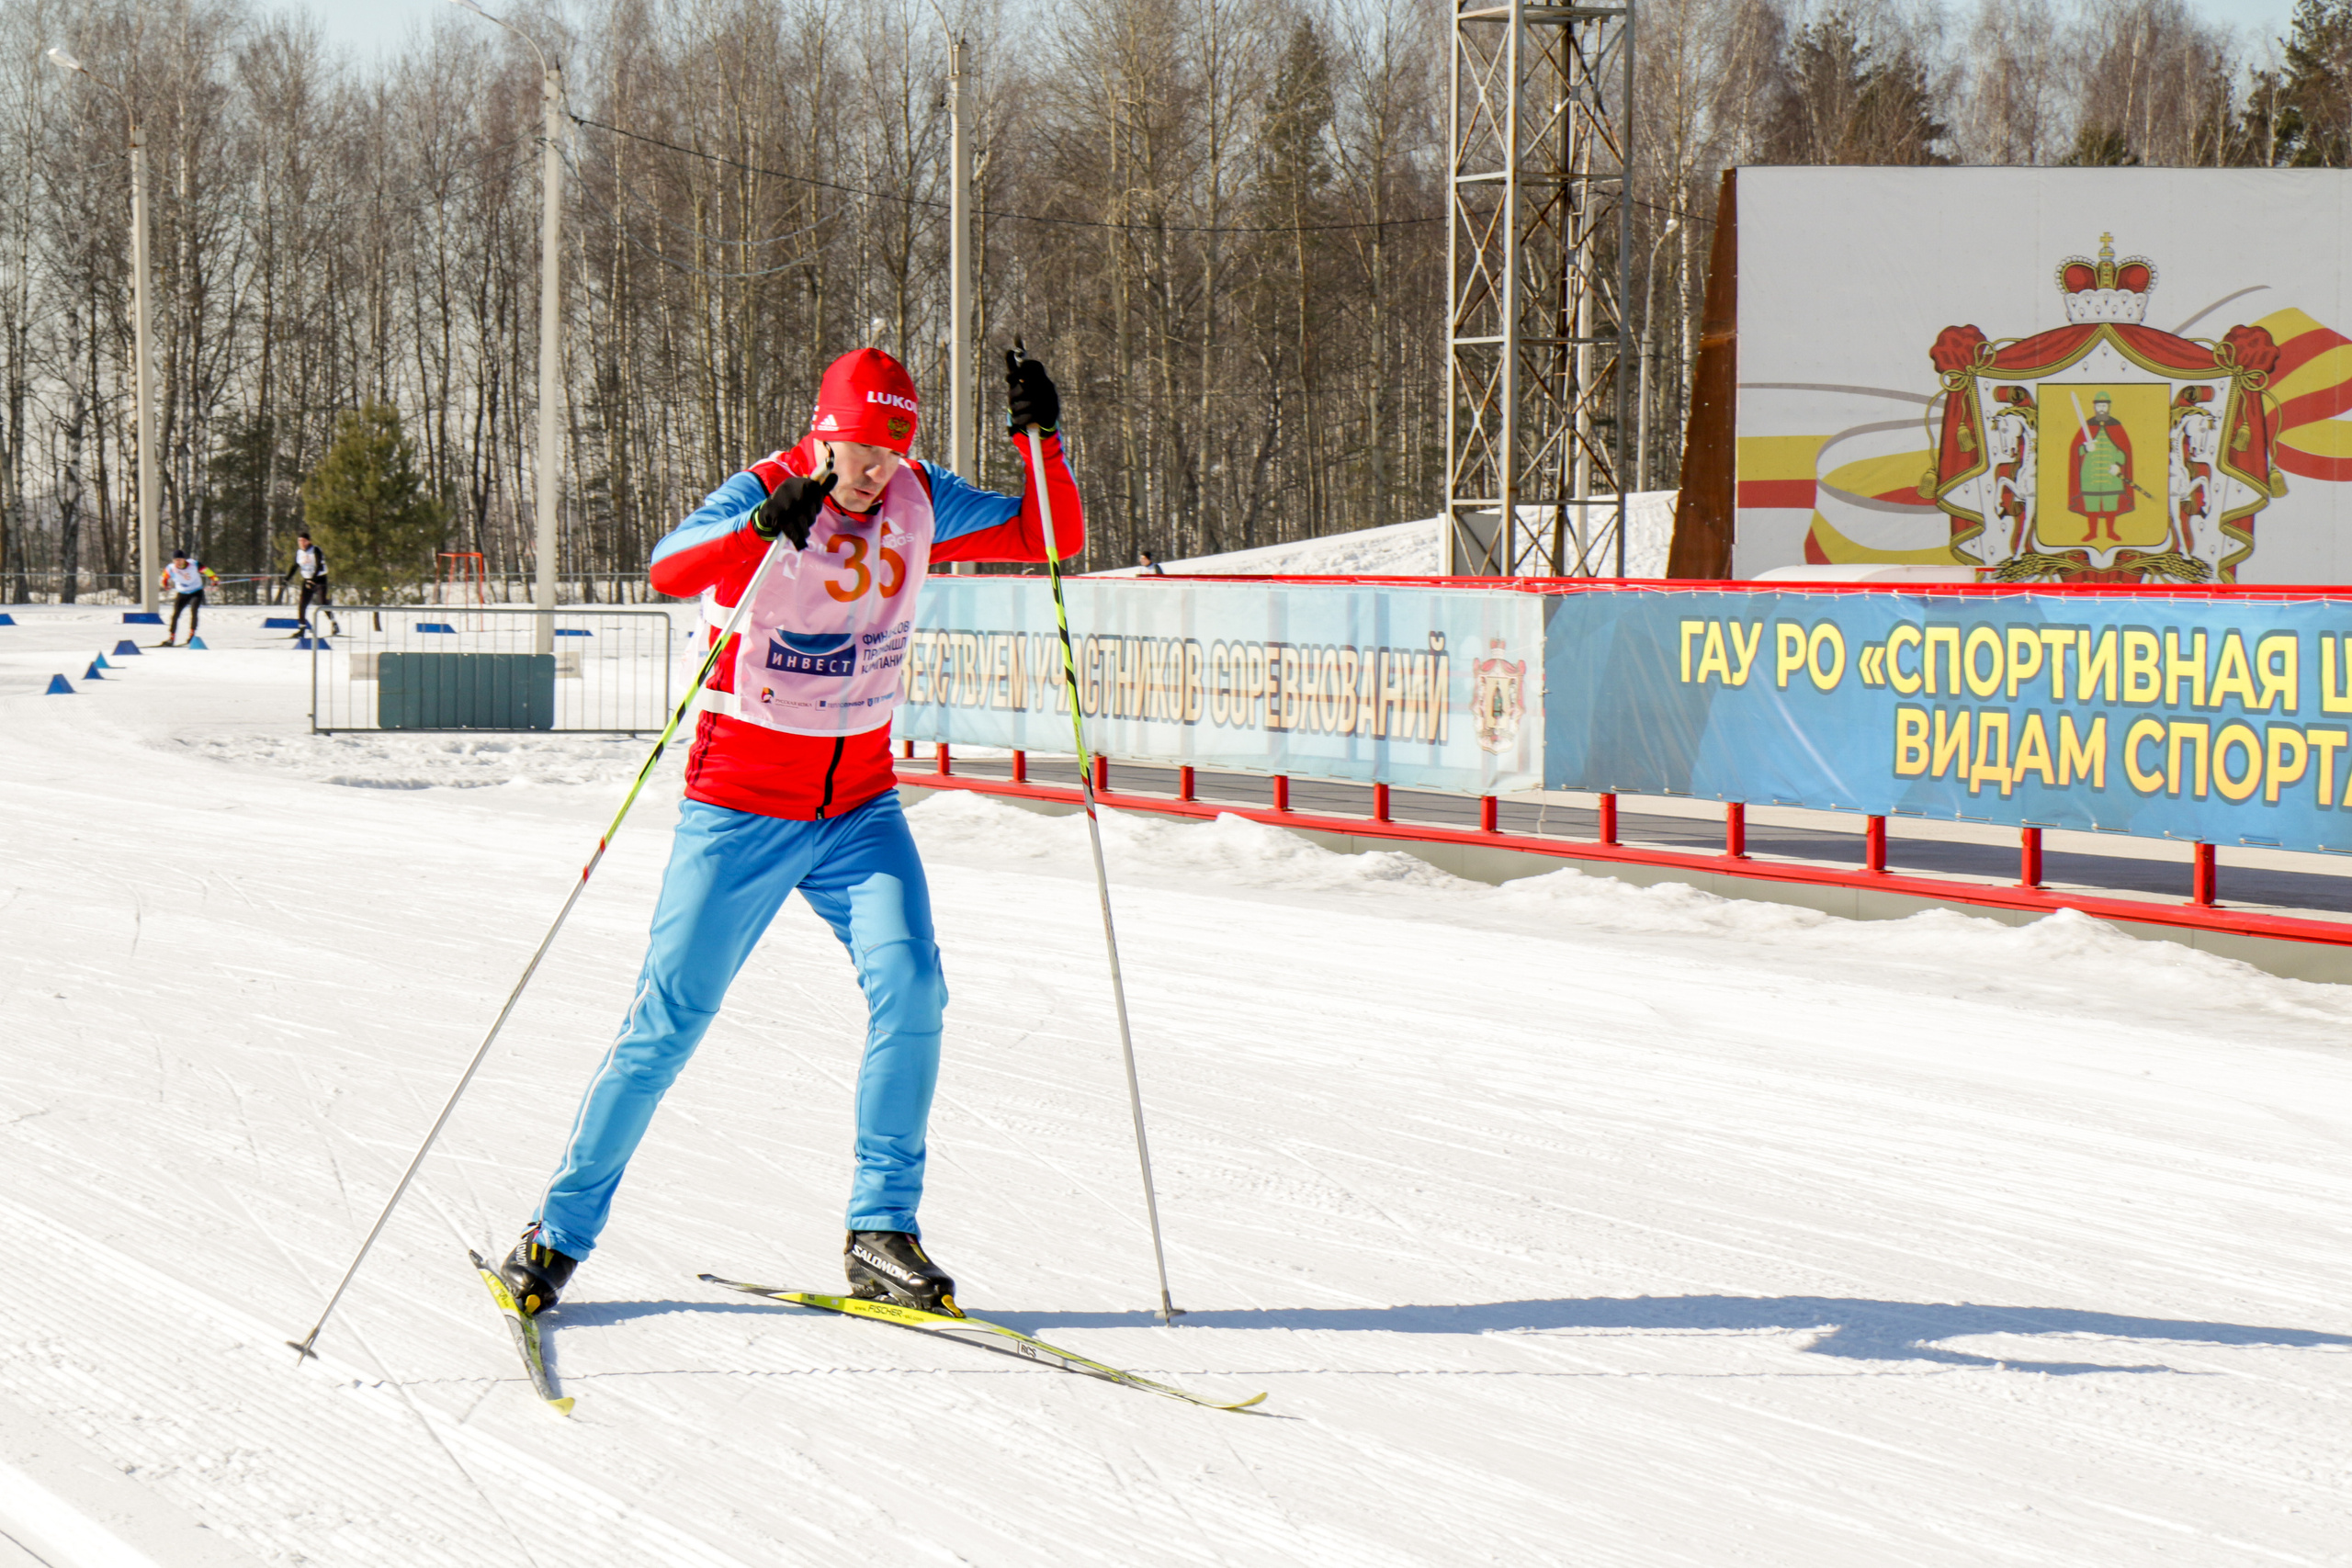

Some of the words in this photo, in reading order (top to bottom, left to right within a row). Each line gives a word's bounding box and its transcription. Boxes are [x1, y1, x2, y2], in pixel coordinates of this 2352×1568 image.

[771, 651, 851, 673] ИНВЕСТ
[1211, 633, 1450, 744] СОРЕВНОВАНИЙ
[1679, 619, 1763, 687] ГАУ
[1777, 622, 1847, 691] РО
[1859, 625, 2299, 712] «СПОРТИВНАЯ
[1894, 706, 2107, 796] ВИДАМ
[852, 1244, 913, 1281] SALOMON
